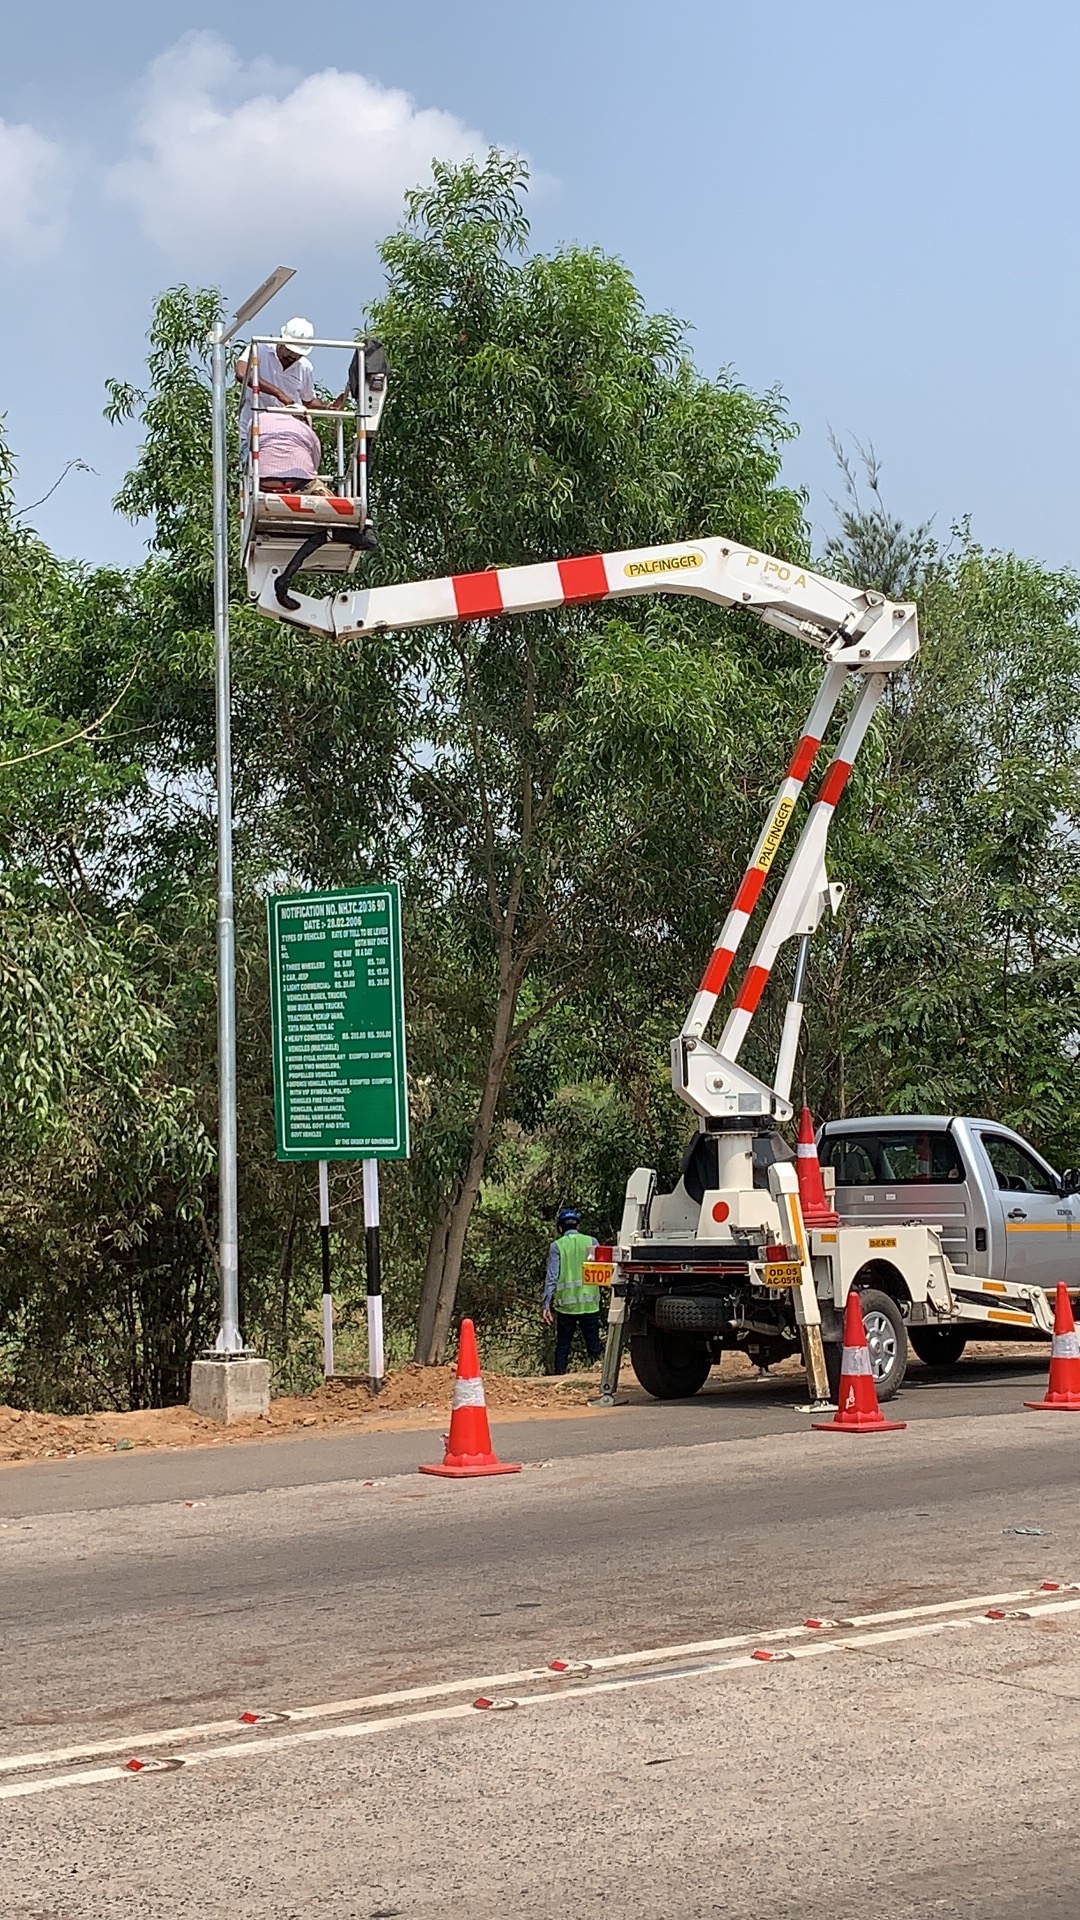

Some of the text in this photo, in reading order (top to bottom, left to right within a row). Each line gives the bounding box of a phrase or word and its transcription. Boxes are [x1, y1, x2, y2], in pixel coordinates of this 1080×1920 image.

[629, 555, 697, 575] PALFINGER
[759, 802, 792, 867] PALFINGER
[282, 905, 325, 920] NOTIFICATION
[326, 904, 338, 915] NO.
[304, 920, 320, 930] DATE
[304, 933, 326, 941] VEHICLES
[584, 1269, 611, 1283] STOP
